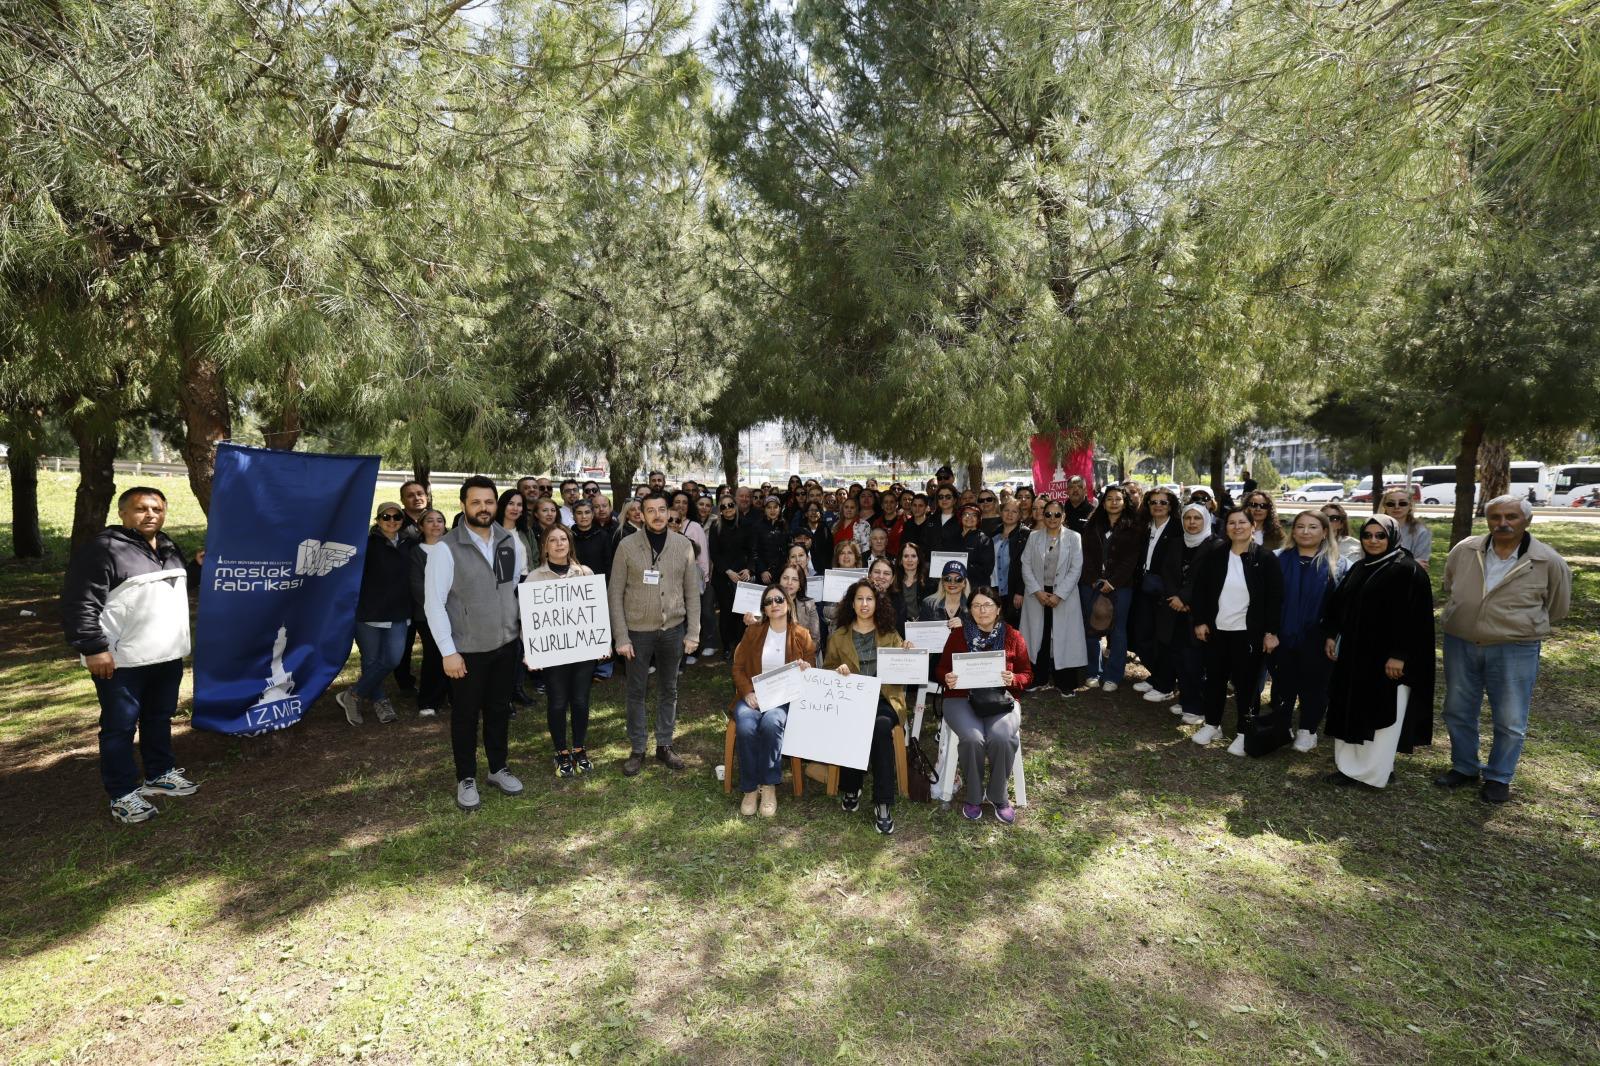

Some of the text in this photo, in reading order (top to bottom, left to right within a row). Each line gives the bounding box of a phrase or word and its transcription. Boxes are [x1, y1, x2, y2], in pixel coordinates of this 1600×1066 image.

[215, 566, 291, 577] meslek
[214, 578, 303, 591] fabrikası
[532, 583, 596, 604] EĞİTİME
[532, 606, 597, 630] BARİKAT
[528, 628, 608, 655] KURULMAZ
[803, 675, 864, 690] NGILIZCE
